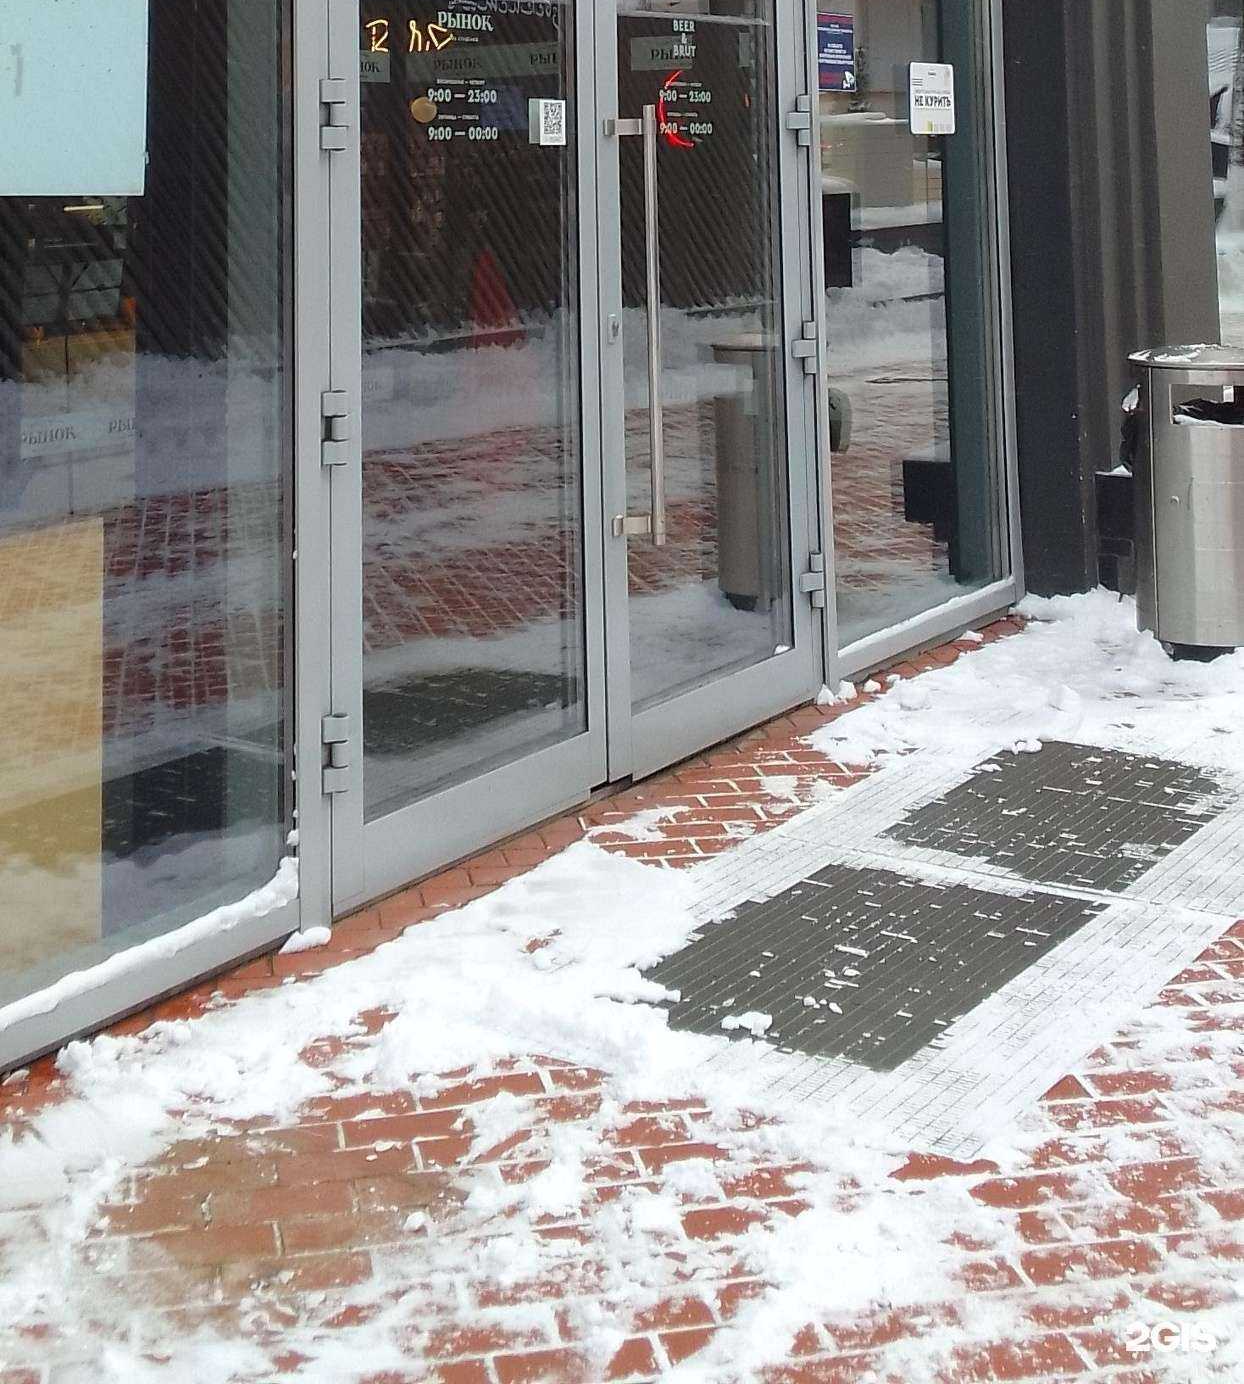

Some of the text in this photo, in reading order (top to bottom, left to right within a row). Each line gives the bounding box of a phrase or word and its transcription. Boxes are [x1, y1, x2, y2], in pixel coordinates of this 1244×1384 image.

[437, 11, 494, 32] РЫНОК
[673, 19, 696, 32] BEER
[673, 45, 697, 57] BRUT
[428, 88, 452, 103] 9:00
[467, 89, 497, 104] 23:00
[659, 89, 677, 102] 9:00
[689, 90, 712, 103] 23:00
[914, 95, 952, 108] НЕ КУРИТЬ
[428, 126, 452, 141] 9:00
[468, 126, 498, 141] 00:00
[659, 122, 678, 134] 9:00
[689, 122, 713, 135] 00:00
